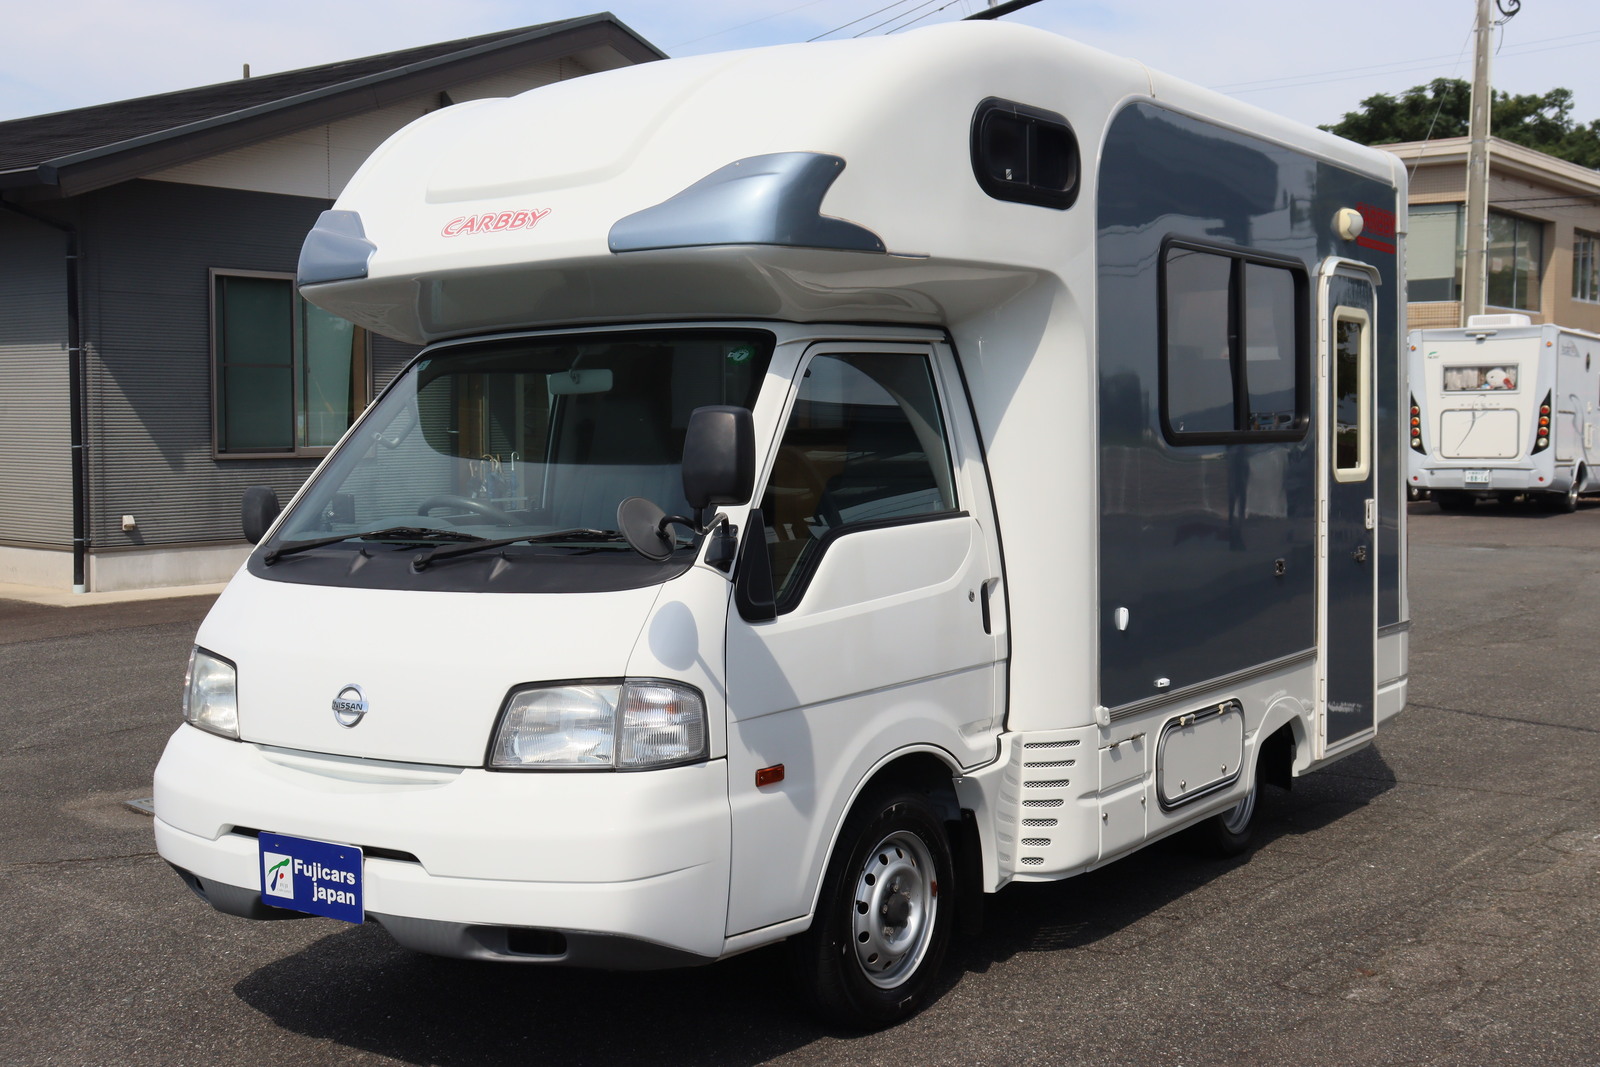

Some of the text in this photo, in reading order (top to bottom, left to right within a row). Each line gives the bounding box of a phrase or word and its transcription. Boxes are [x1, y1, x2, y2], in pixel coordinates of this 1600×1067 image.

[441, 207, 552, 238] CARBBY
[333, 700, 363, 711] NISSAN
[294, 858, 356, 885] Fujicars
[312, 882, 356, 906] japan
